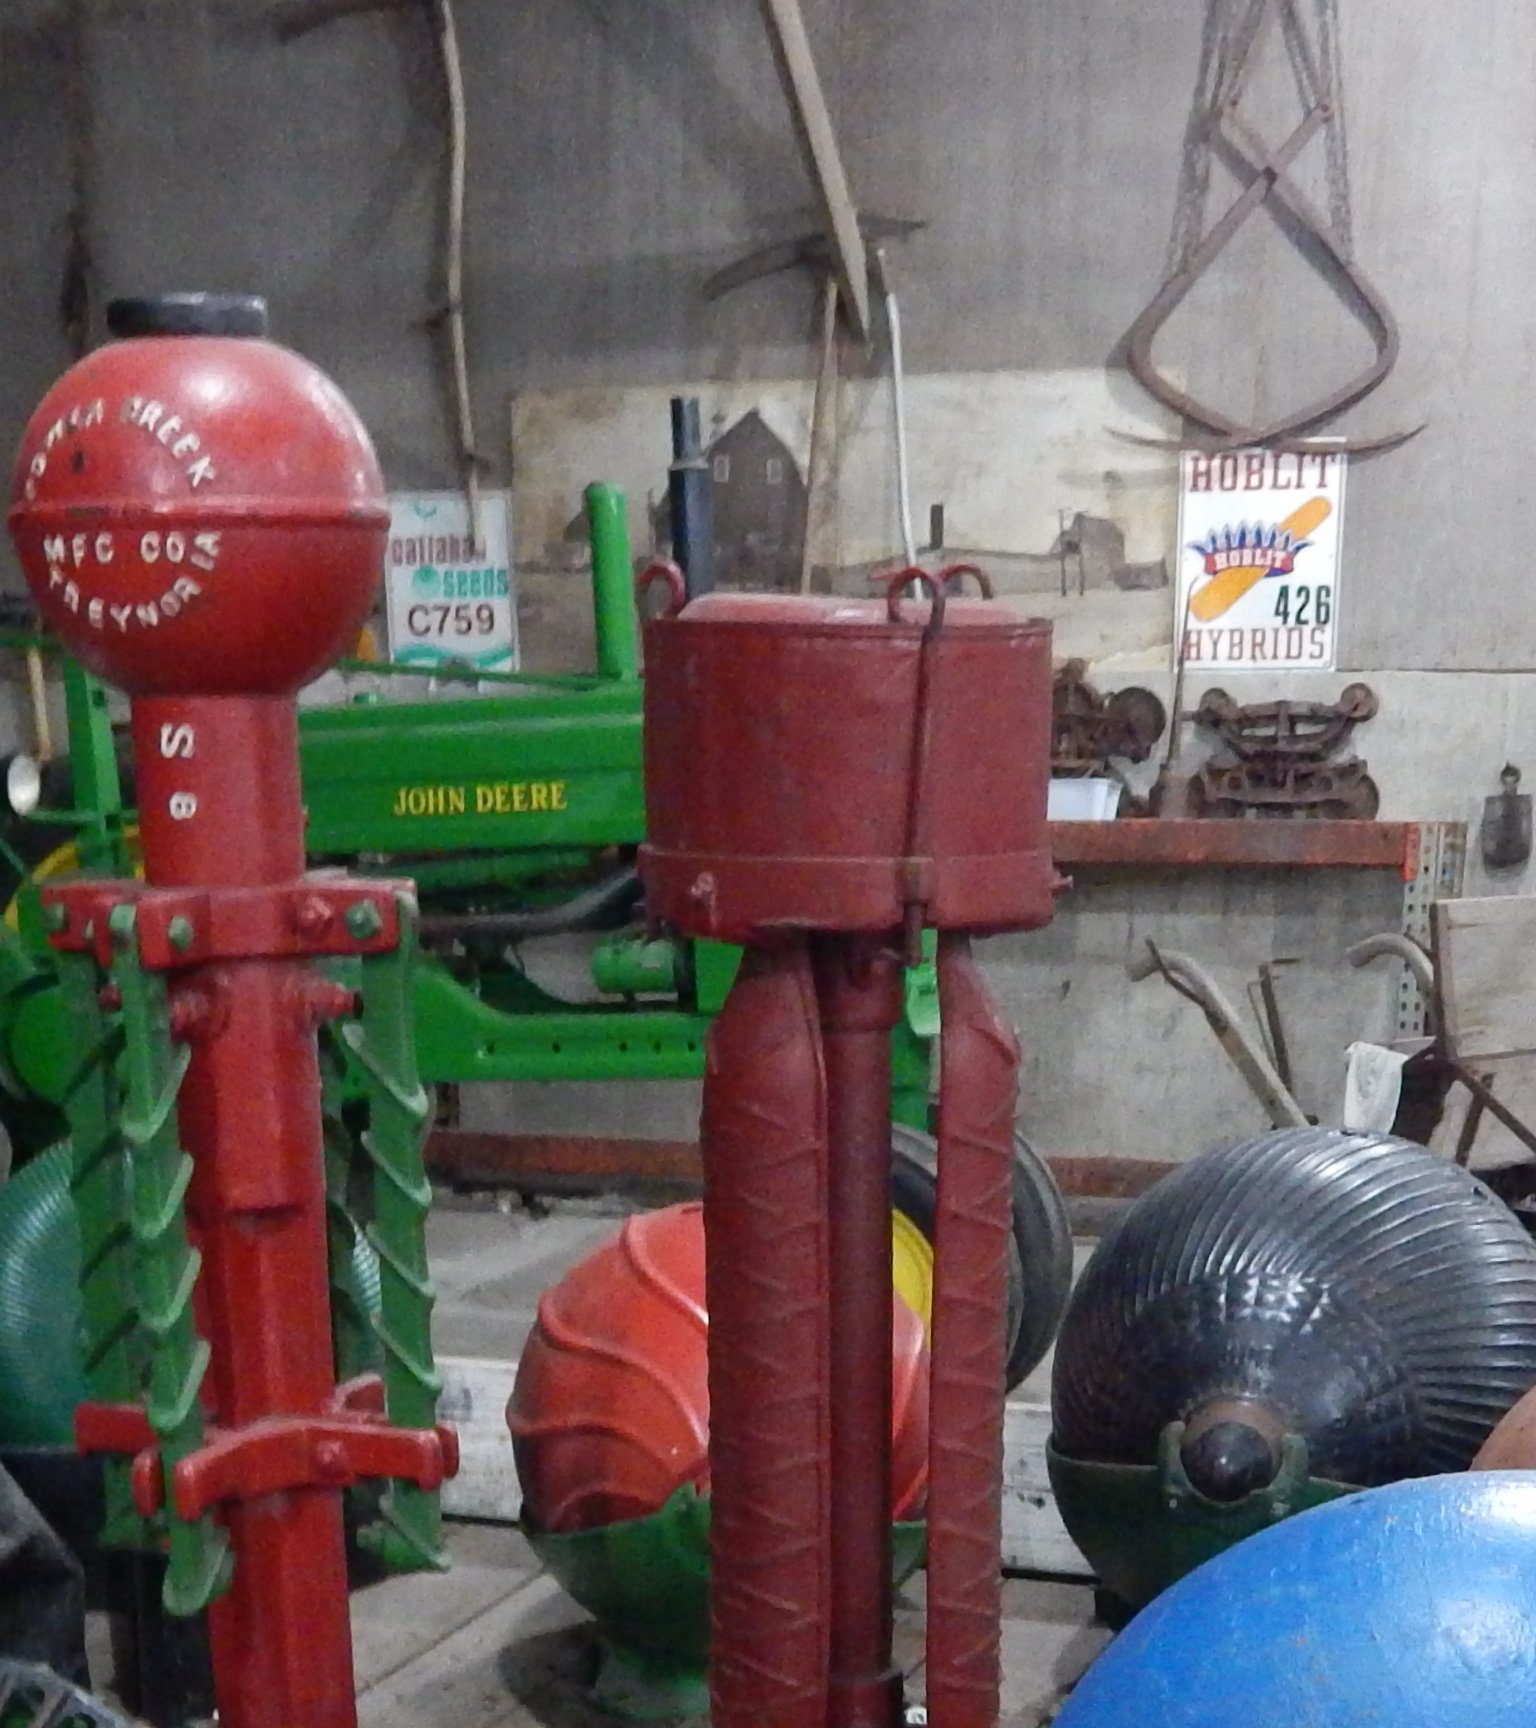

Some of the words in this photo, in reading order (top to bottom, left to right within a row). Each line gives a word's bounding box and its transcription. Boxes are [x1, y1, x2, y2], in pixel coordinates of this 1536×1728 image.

[1190, 453, 1336, 492] HOBLIT
[141, 531, 185, 564] CO
[1215, 550, 1286, 568] HOBLIT
[408, 602, 495, 637] C759
[1274, 584, 1331, 626] 426
[1184, 627, 1326, 662] HYBRIDS
[394, 787, 465, 816] JOHN
[475, 782, 567, 814] DEERE
